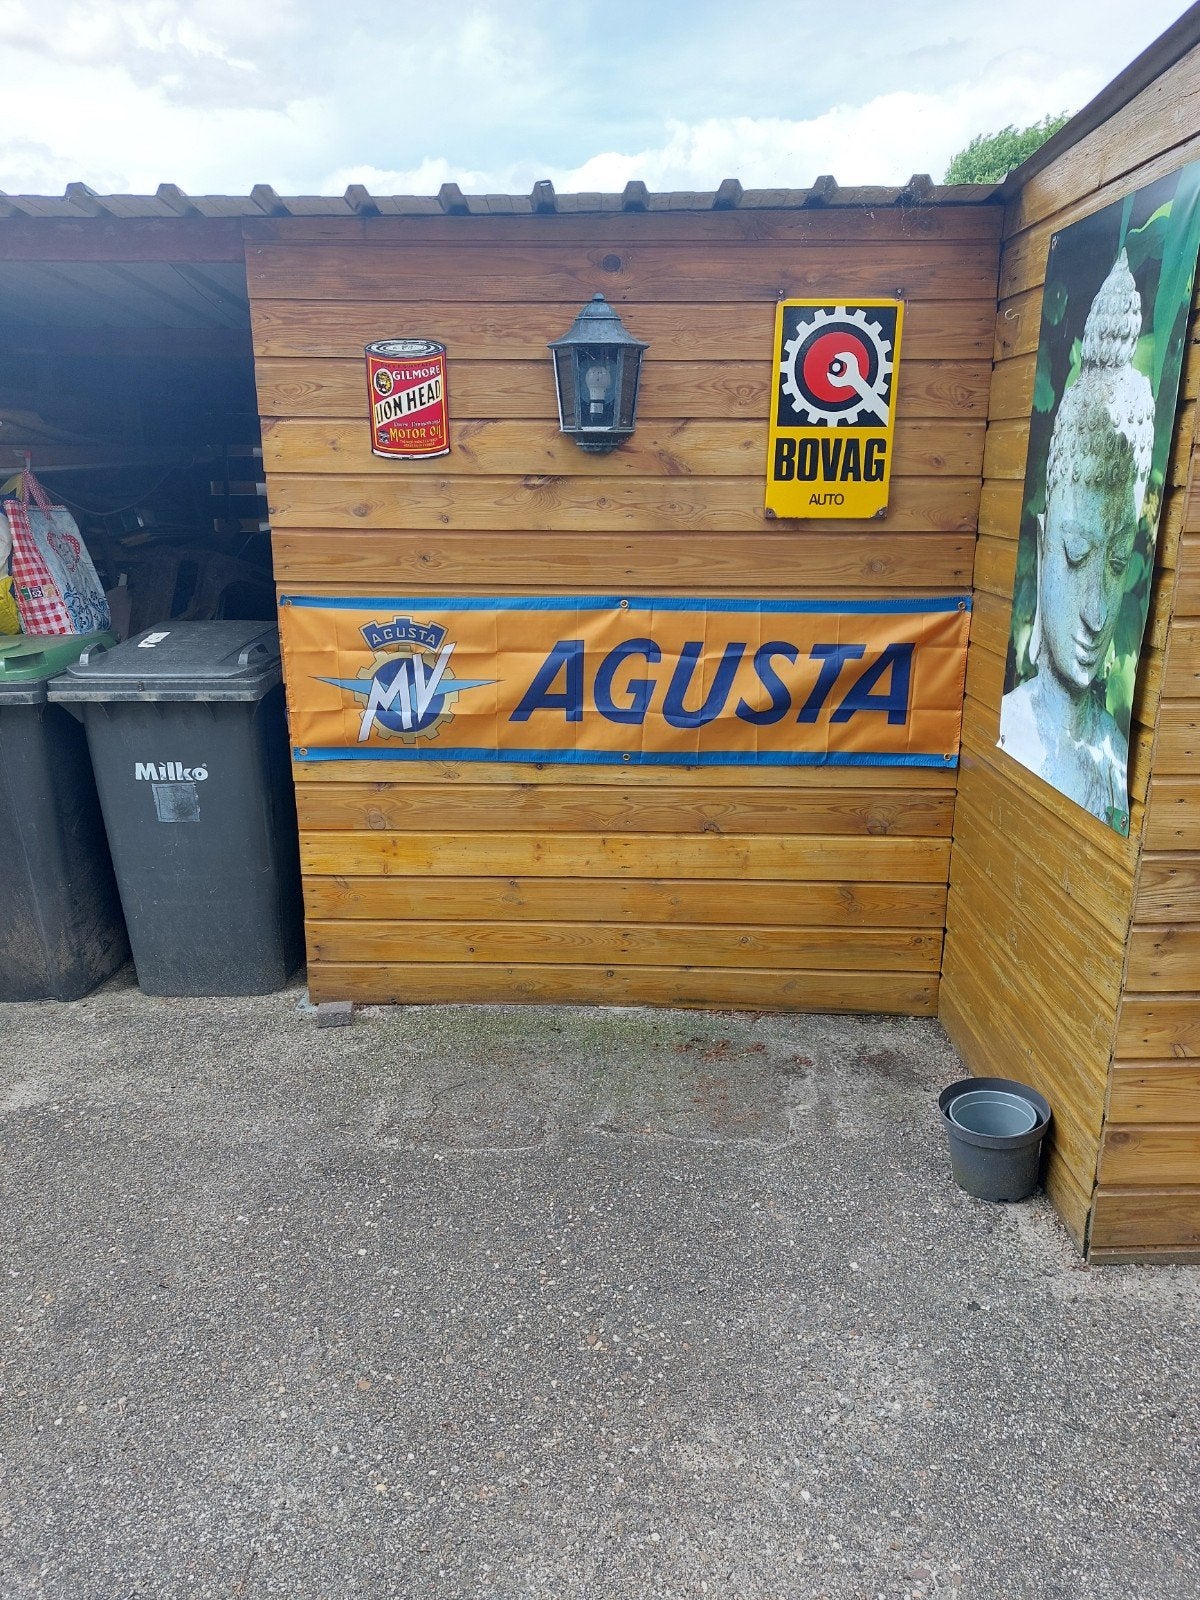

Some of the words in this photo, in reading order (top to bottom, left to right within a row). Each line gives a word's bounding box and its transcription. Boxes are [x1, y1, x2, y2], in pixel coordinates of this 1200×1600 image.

[393, 365, 440, 380] GILMORE
[376, 395, 403, 424] LION
[406, 380, 441, 411] HEAD
[389, 427, 426, 442] MOTOR
[429, 424, 443, 439] OIL
[774, 438, 887, 482] BOVAG
[808, 493, 845, 505] AUTO
[372, 627, 436, 645] AGUSTA
[357, 641, 457, 743] MV
[508, 638, 917, 728] AGUSTA
